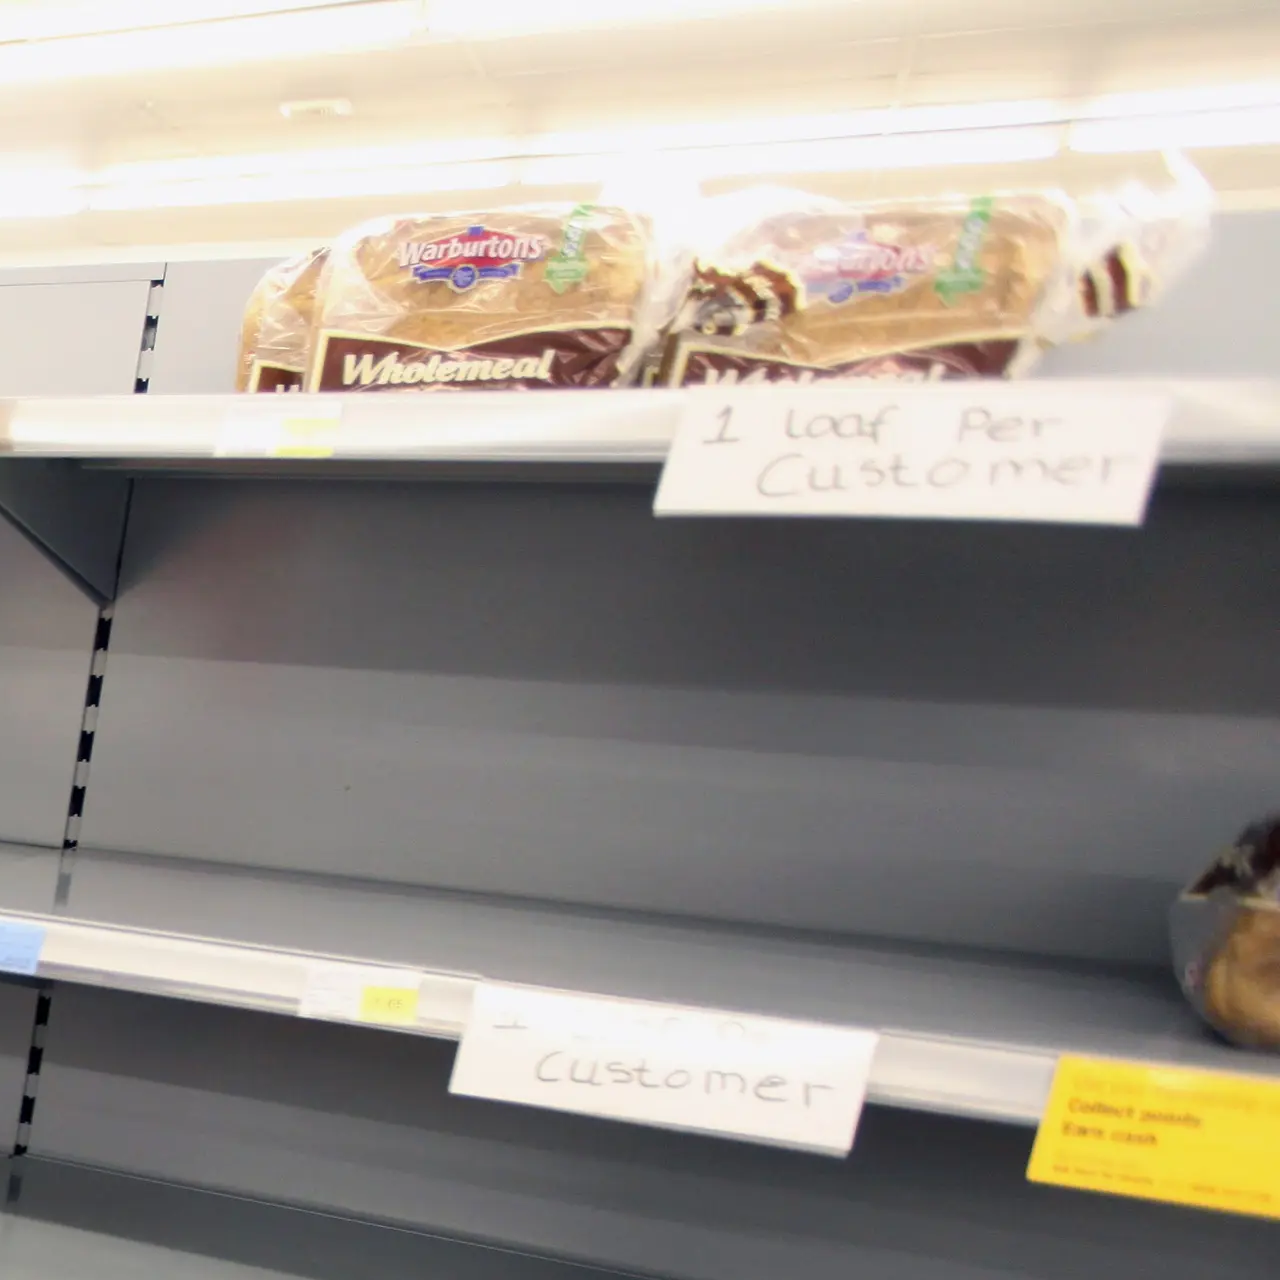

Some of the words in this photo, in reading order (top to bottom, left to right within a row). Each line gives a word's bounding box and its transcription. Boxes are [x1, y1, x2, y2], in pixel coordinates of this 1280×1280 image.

[399, 236, 545, 267] Warburtons
[341, 349, 557, 387] Wholemeal
[702, 405, 740, 445] 1
[756, 449, 1142, 498] Customer
[534, 1049, 836, 1108] Customer
